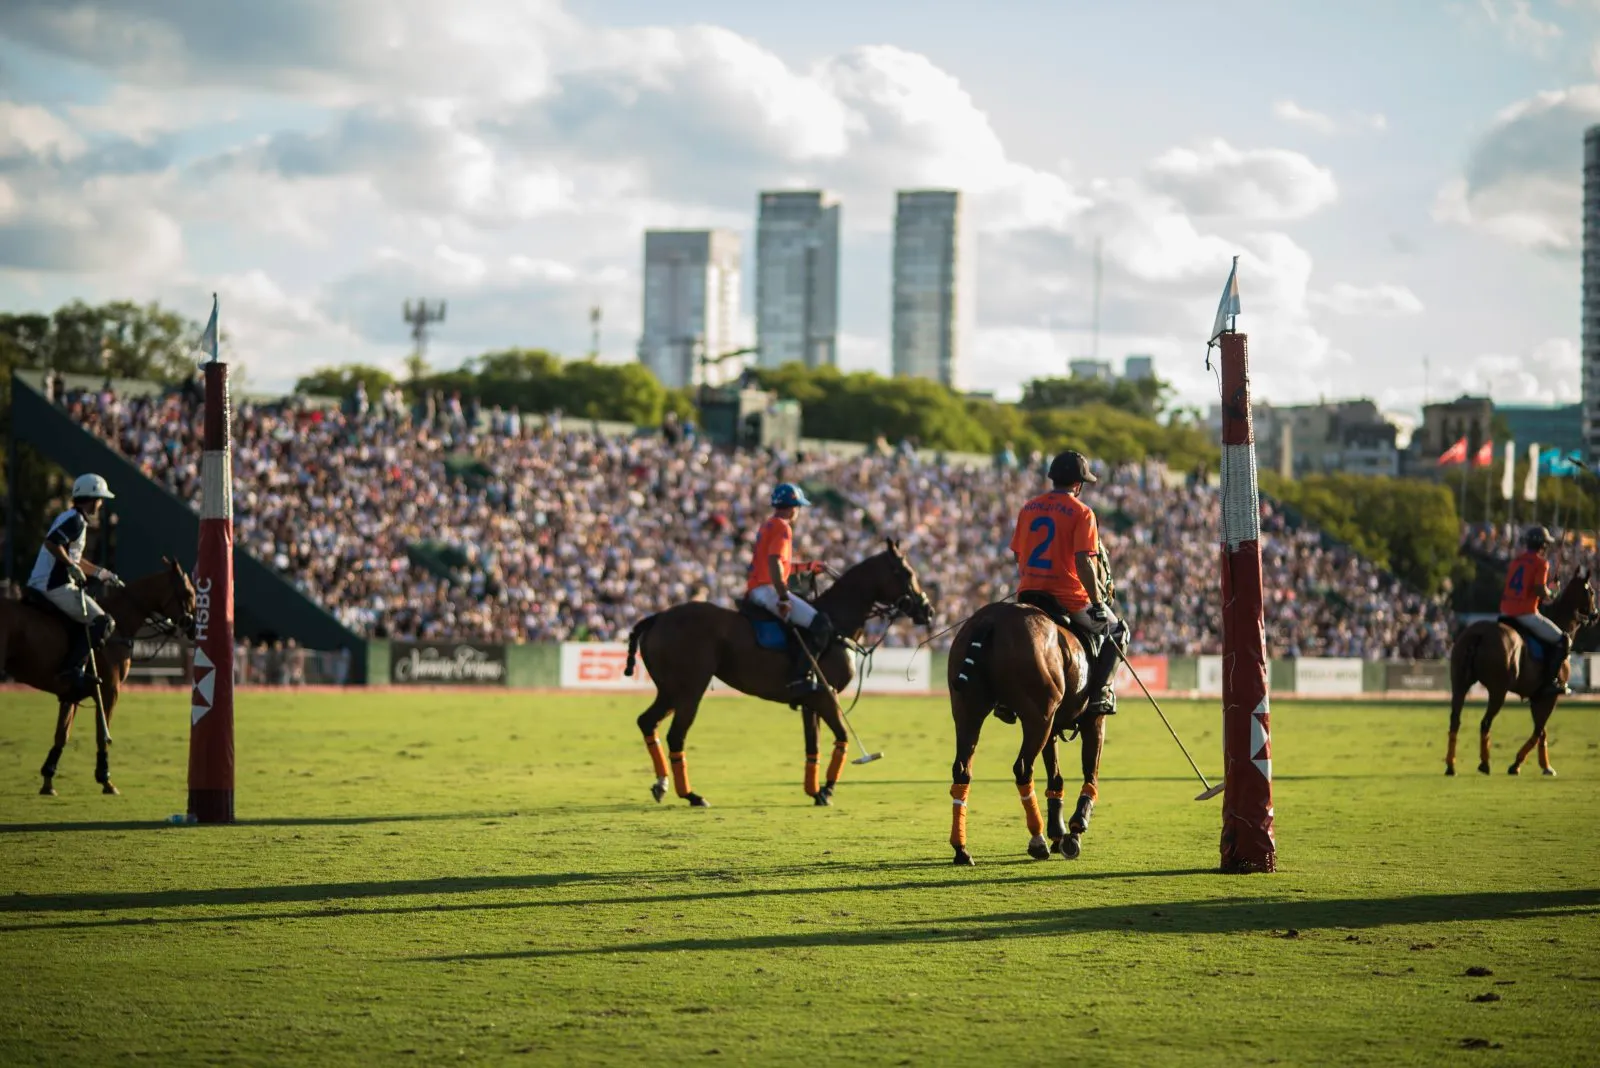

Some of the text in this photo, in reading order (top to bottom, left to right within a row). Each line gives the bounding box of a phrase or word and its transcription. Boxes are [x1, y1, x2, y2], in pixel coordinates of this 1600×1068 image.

[1027, 516, 1055, 570] 2
[1509, 565, 1525, 594] 4
[195, 578, 212, 641] HSBC
